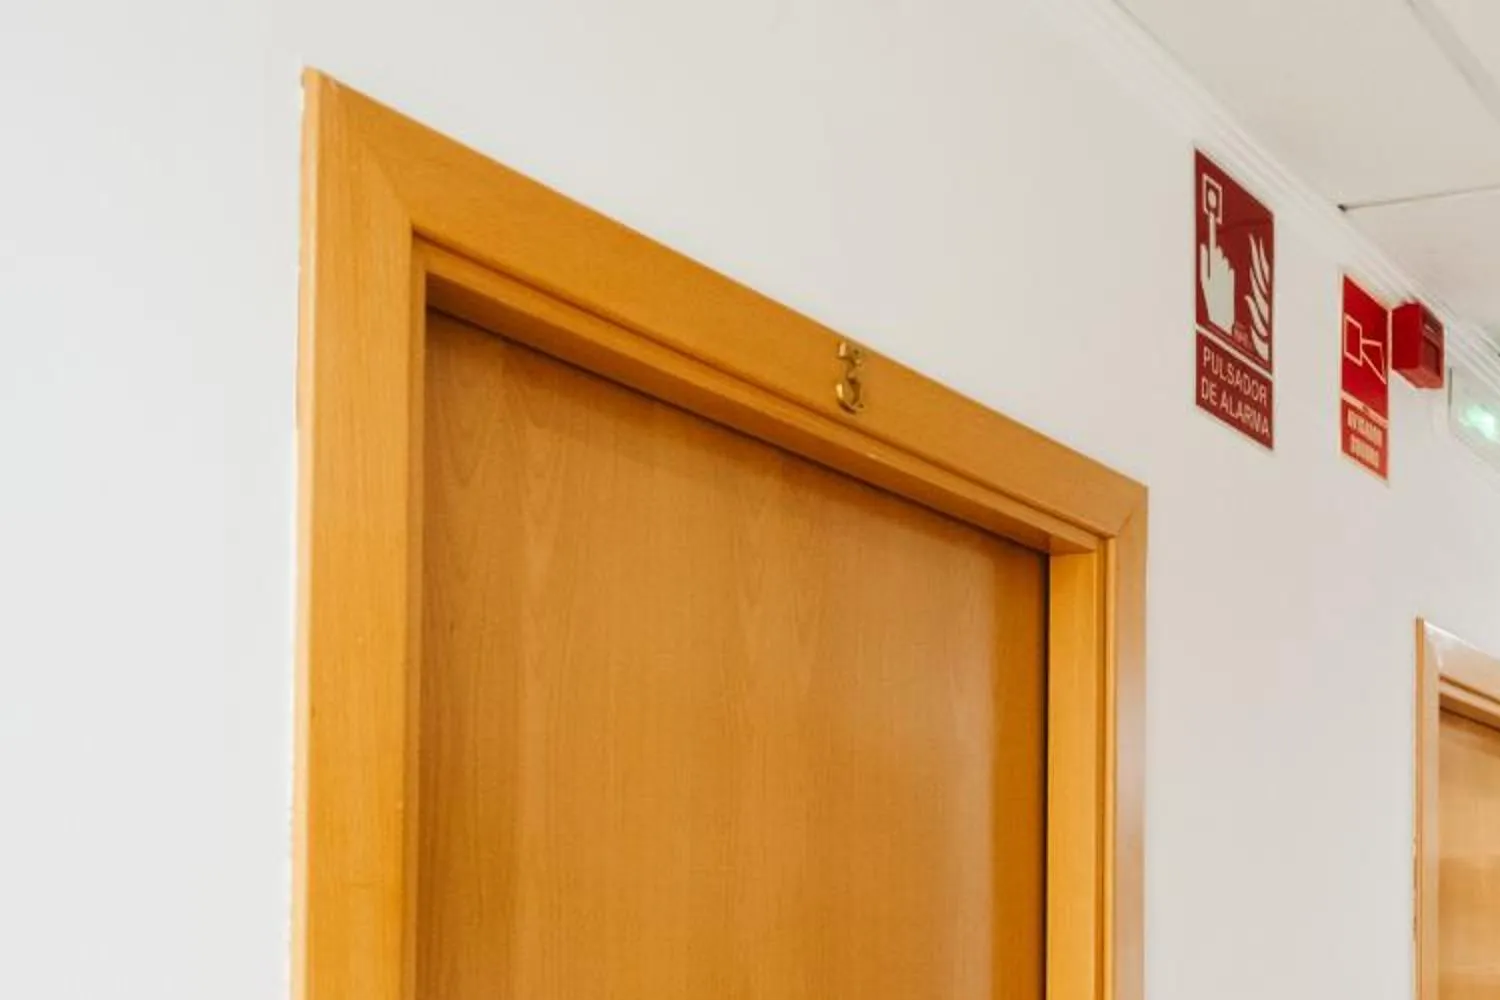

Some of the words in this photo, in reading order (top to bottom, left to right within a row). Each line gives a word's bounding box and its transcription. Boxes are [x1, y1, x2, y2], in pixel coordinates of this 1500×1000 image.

[836, 341, 865, 415] 3
[1201, 376, 1218, 407] DE
[1220, 390, 1271, 439] ALARMA
[1202, 344, 1268, 408] PULSADOR
